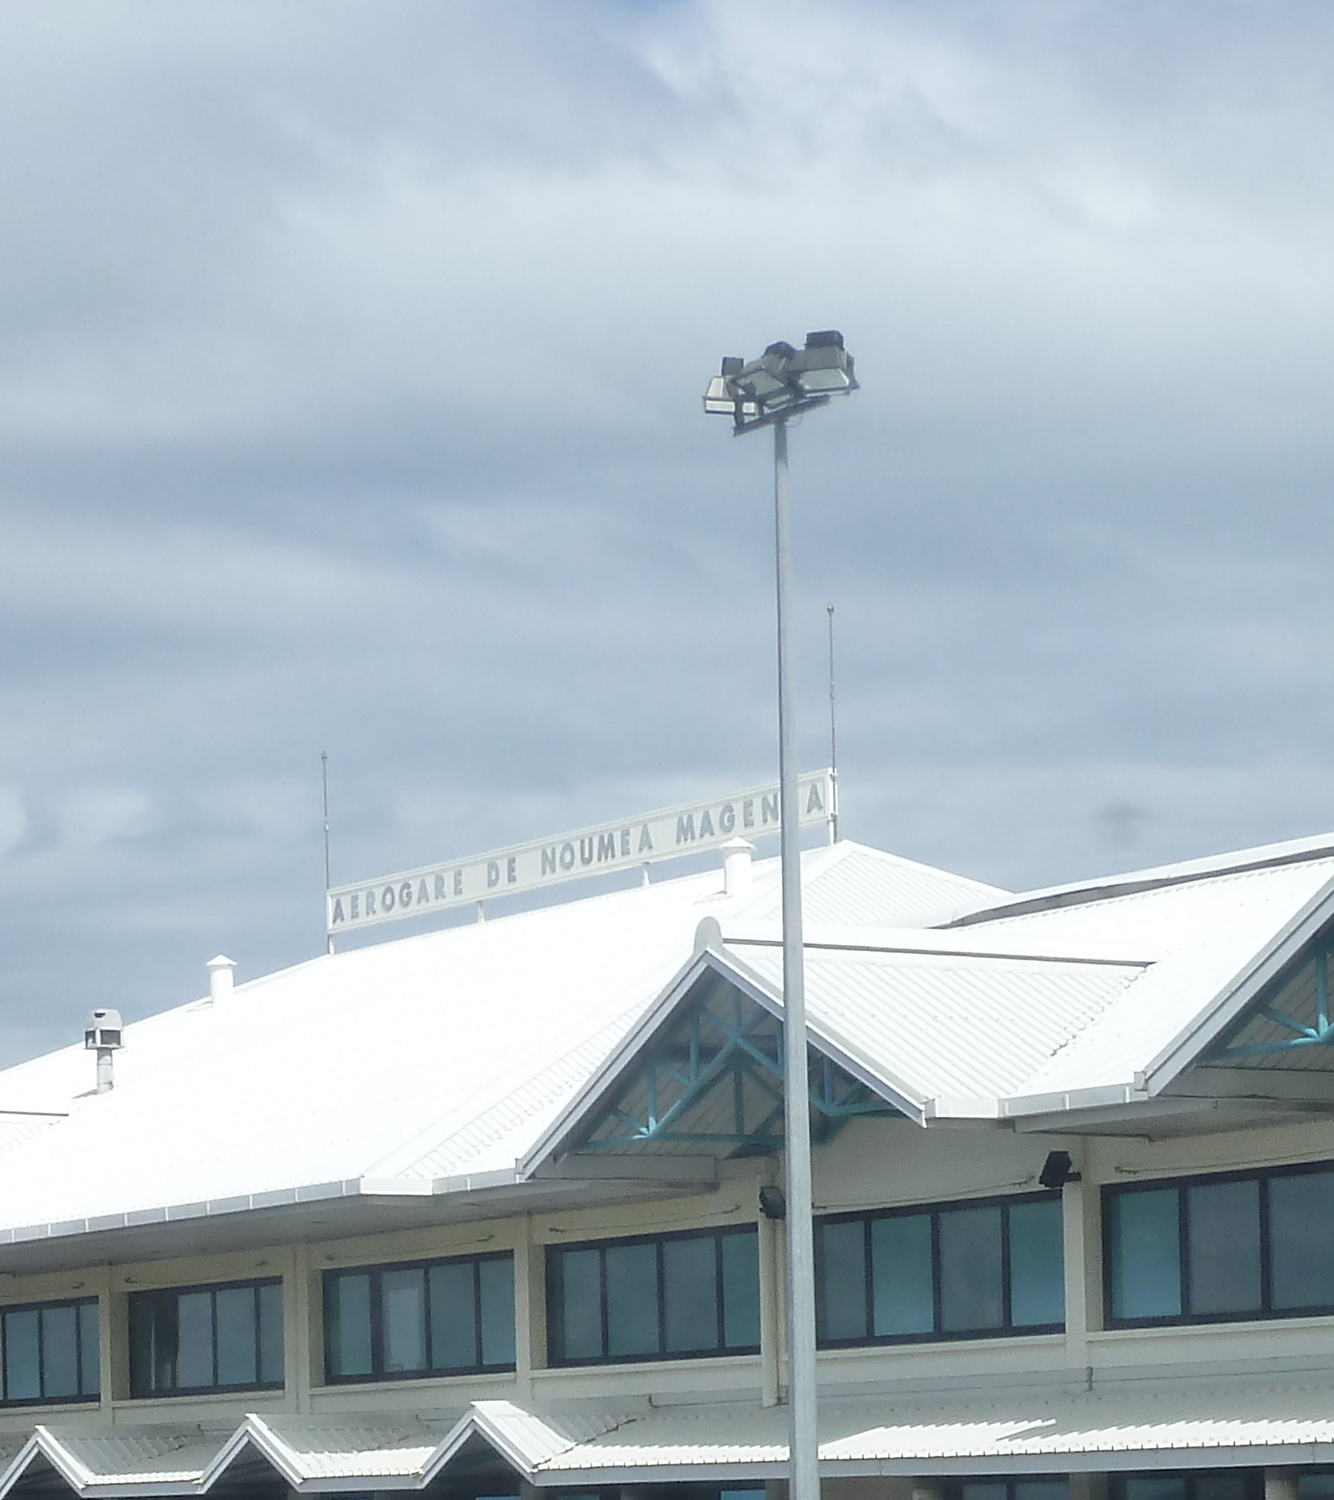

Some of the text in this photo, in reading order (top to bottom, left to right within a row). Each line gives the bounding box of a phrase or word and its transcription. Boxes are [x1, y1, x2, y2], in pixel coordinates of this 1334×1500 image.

[332, 783, 823, 924] AEROGARE DE NOUMEA MAGENA
